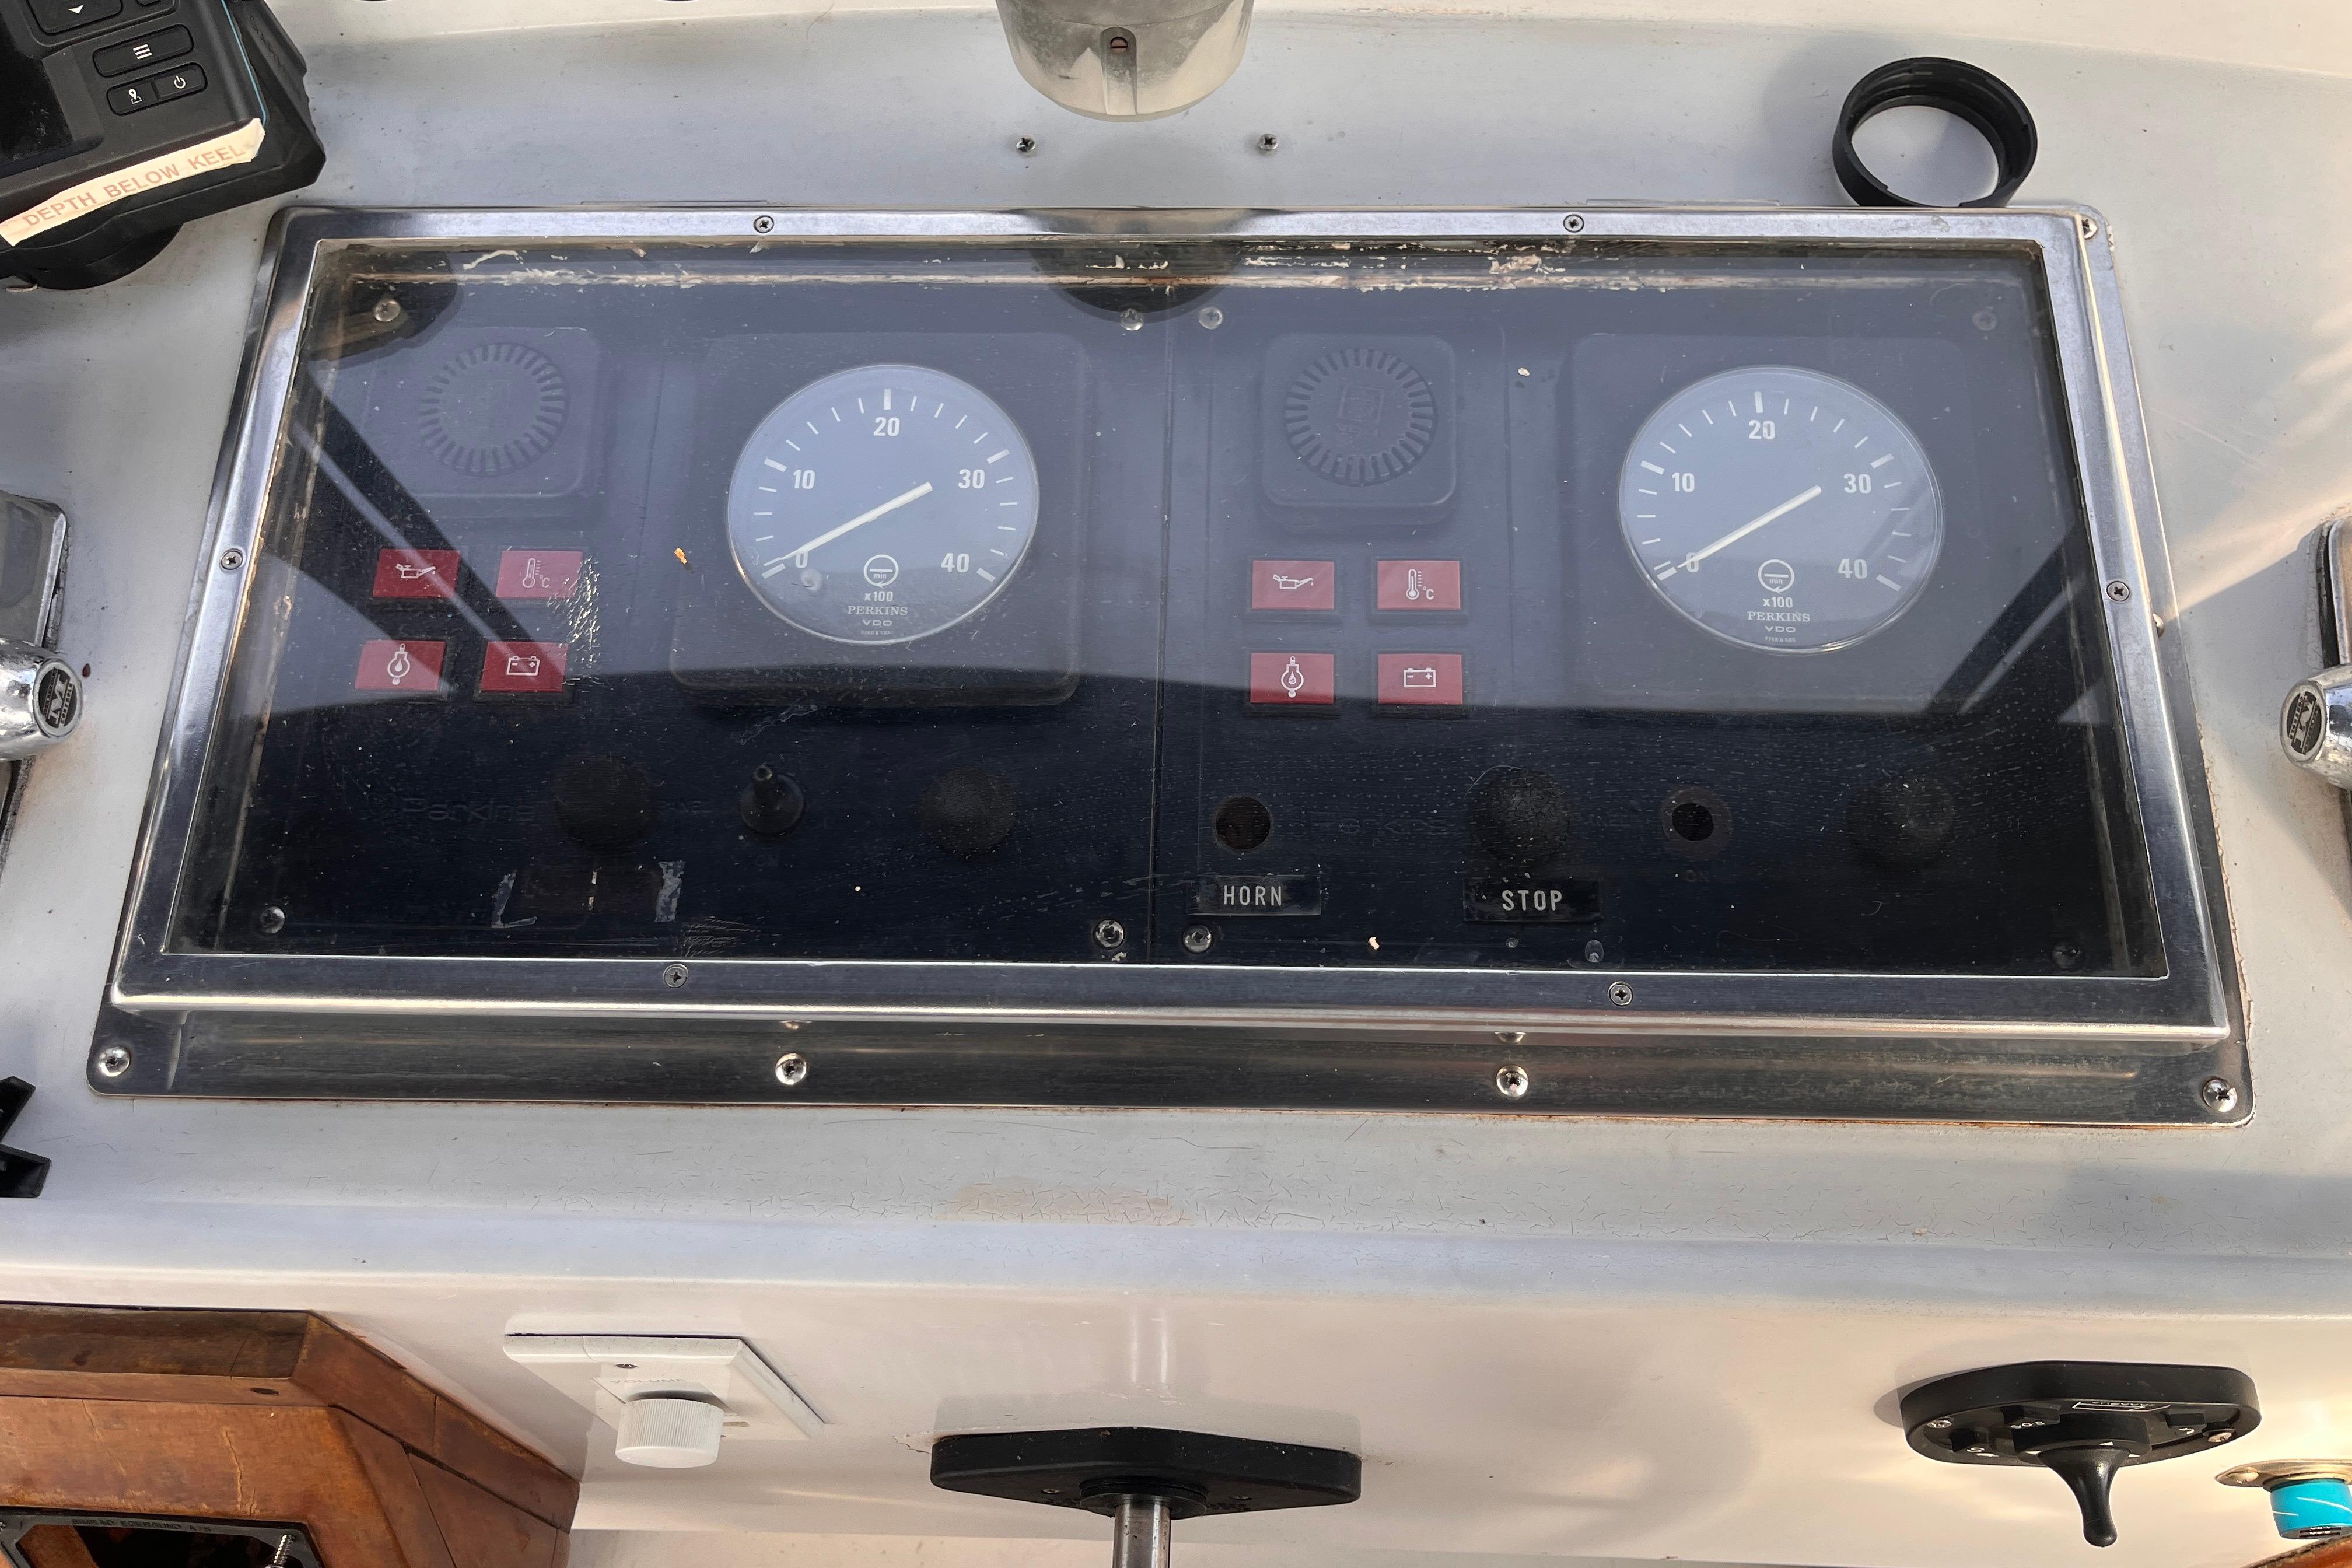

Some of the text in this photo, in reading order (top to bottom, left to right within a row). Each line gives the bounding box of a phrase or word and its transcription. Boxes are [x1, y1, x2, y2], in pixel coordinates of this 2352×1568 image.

[23, 145, 246, 226] DEPTH BELOW KEEL
[874, 417, 900, 436] 20
[1749, 420, 1775, 439] 20
[793, 470, 816, 489] 10
[958, 469, 985, 489] 30
[1672, 473, 1695, 492] 10
[1844, 473, 1871, 494] 30
[796, 550, 808, 569] 0
[941, 553, 970, 572] 40
[1686, 552, 1699, 572] 0
[1838, 559, 1867, 579] 40
[848, 606, 908, 615] PERKINS
[1746, 611, 1810, 622] PERKINS
[1224, 885, 1283, 907] HORN
[1502, 890, 1563, 911] STOP
